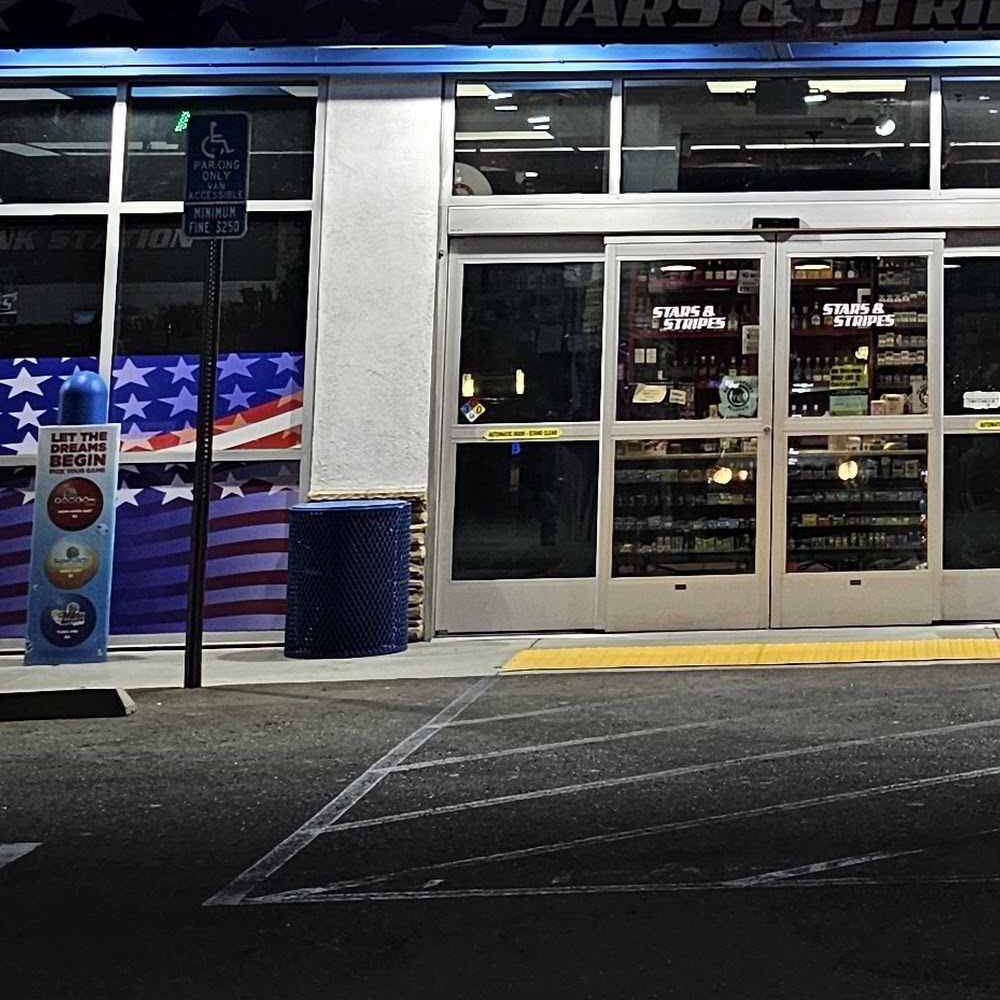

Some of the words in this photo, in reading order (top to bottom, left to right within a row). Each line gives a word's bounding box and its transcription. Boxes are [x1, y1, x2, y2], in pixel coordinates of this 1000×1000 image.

[193, 160, 240, 170] PARKING
[202, 171, 231, 181] ONLY
[208, 182, 225, 190] VAN
[188, 191, 243, 200] ACCESSIBLE
[193, 206, 236, 218] MINIMUM
[188, 221, 209, 234] FINE
[216, 220, 240, 234] $250
[652, 305, 700, 319] STARS
[702, 305, 715, 317] &
[822, 303, 870, 316] STARS
[659, 316, 726, 331] STRIPES
[832, 314, 895, 327] STRIPES
[51, 432, 77, 443] LET
[80, 431, 108, 441] THE
[50, 442, 107, 453] DREAMS
[49, 454, 106, 467] BEGIN
